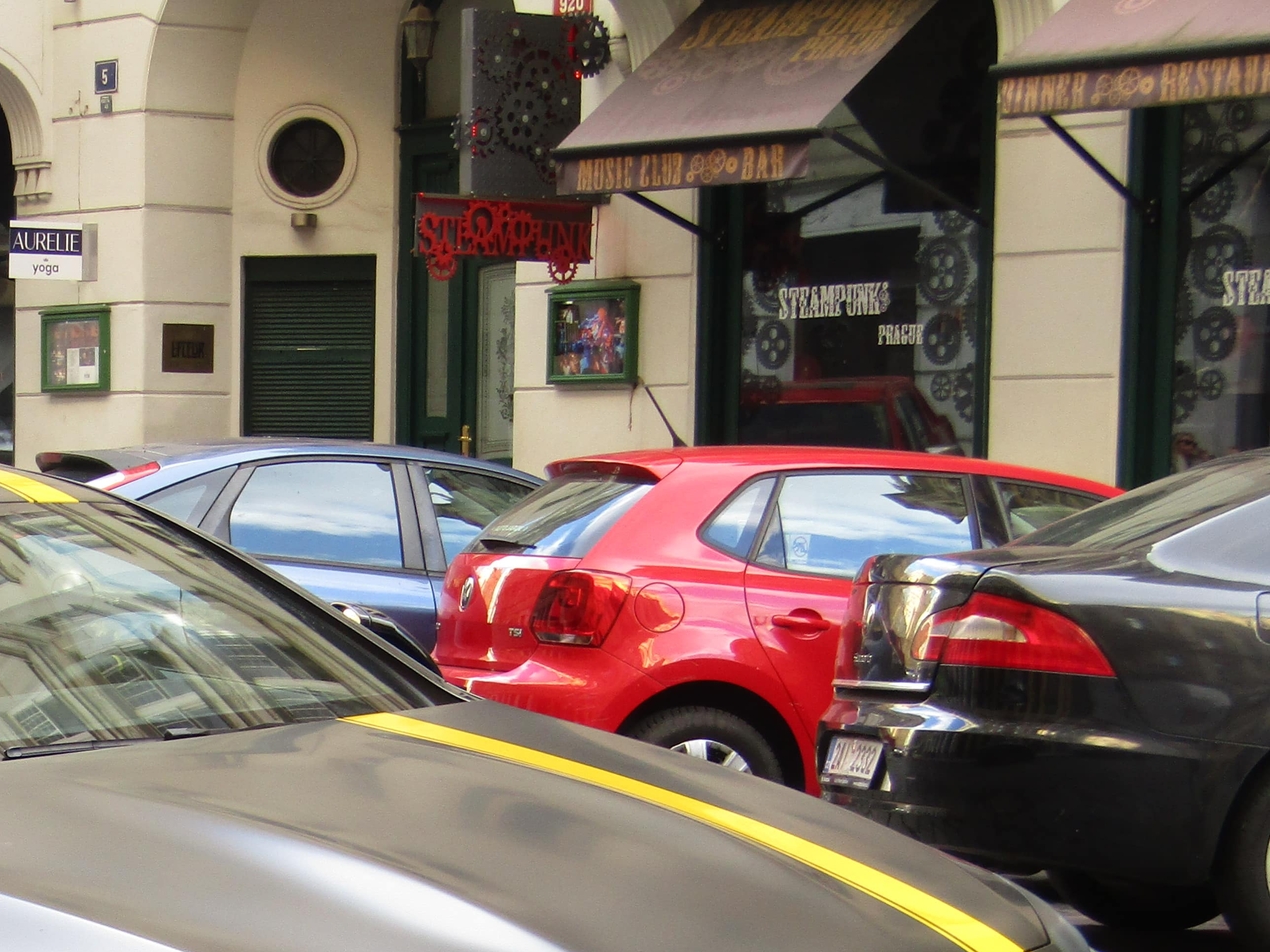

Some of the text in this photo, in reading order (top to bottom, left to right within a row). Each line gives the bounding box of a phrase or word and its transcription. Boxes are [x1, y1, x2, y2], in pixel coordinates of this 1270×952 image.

[559, 0, 584, 13] 920
[101, 68, 109, 85] 5
[577, 144, 785, 191] MUSIC CLUB BAR
[12, 231, 80, 253] AURELIE
[418, 208, 595, 261] STEAMPUNK
[32, 262, 59, 275] yoga
[778, 281, 882, 320] STEAMPUNK
[877, 324, 925, 346] PRAGUE
